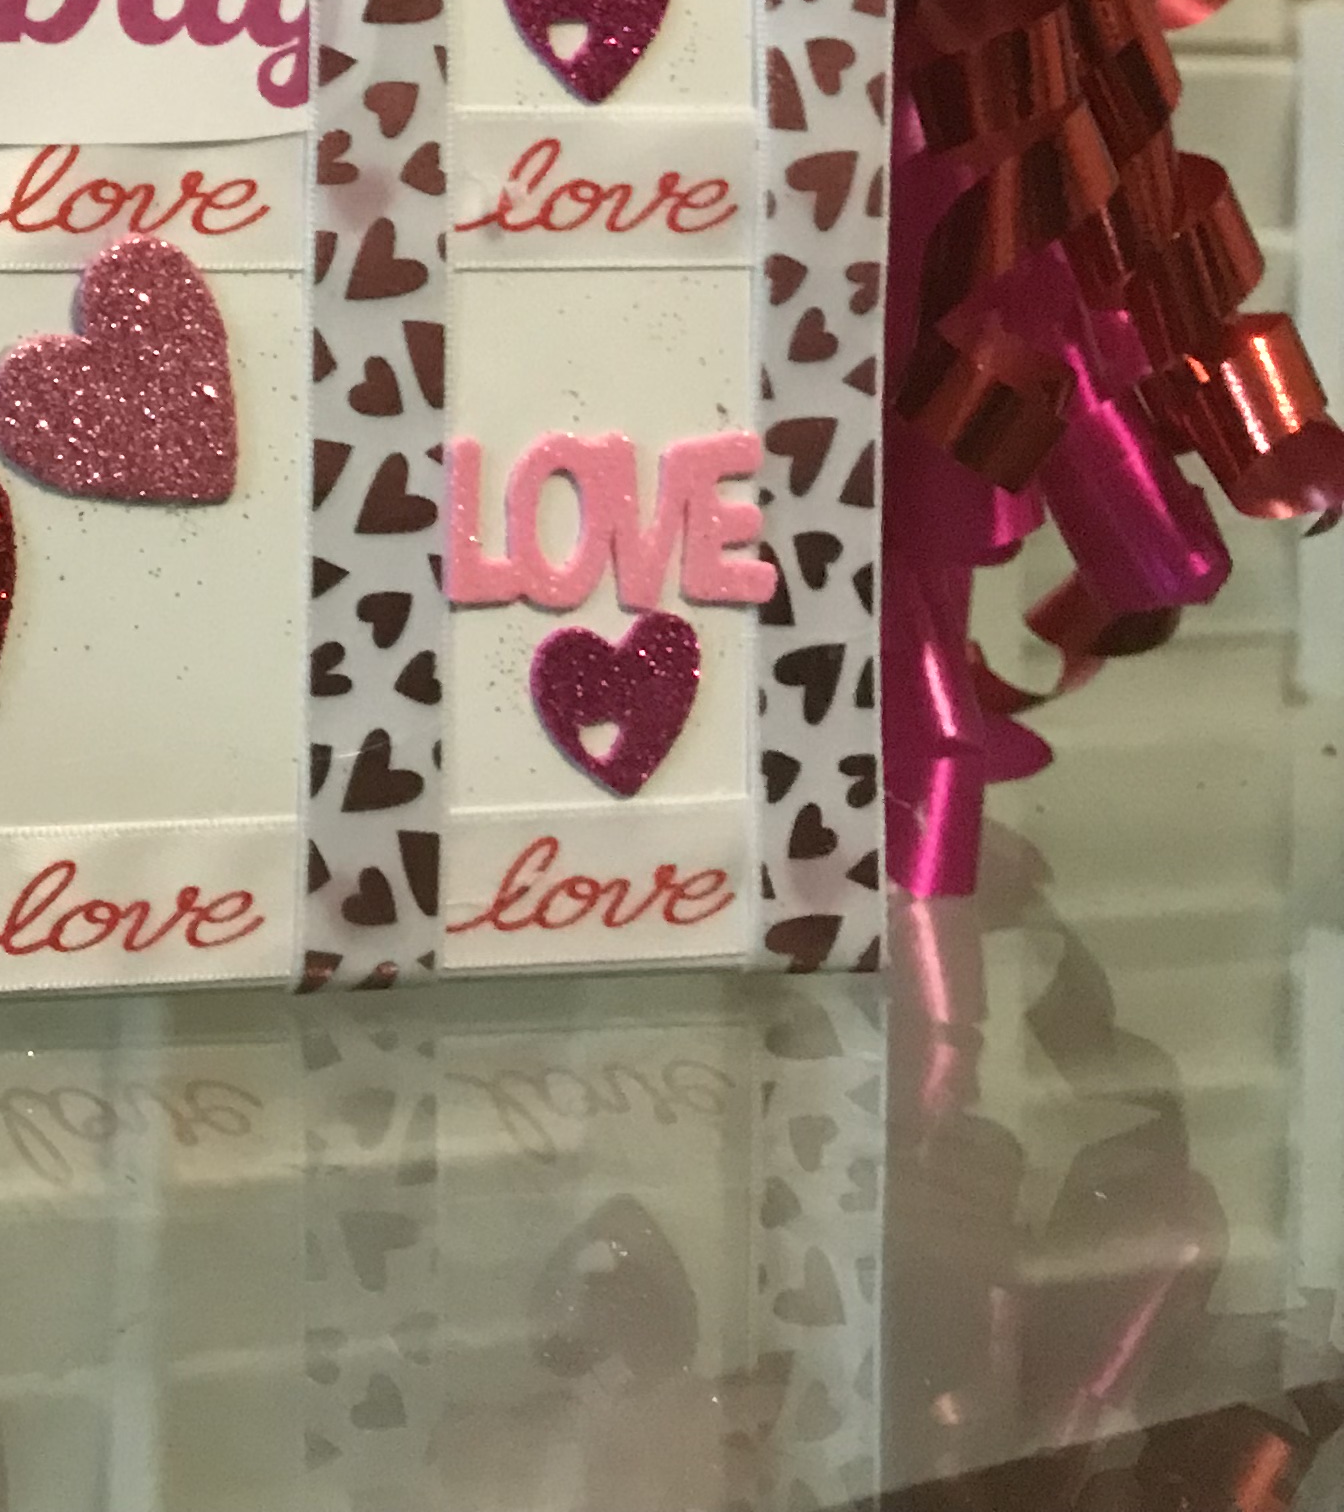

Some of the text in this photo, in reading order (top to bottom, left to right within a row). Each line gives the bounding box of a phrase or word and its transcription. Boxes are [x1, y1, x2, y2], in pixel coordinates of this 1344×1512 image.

[454, 139, 736, 234] love
[446, 431, 778, 613] LOVE
[448, 836, 736, 933] love
